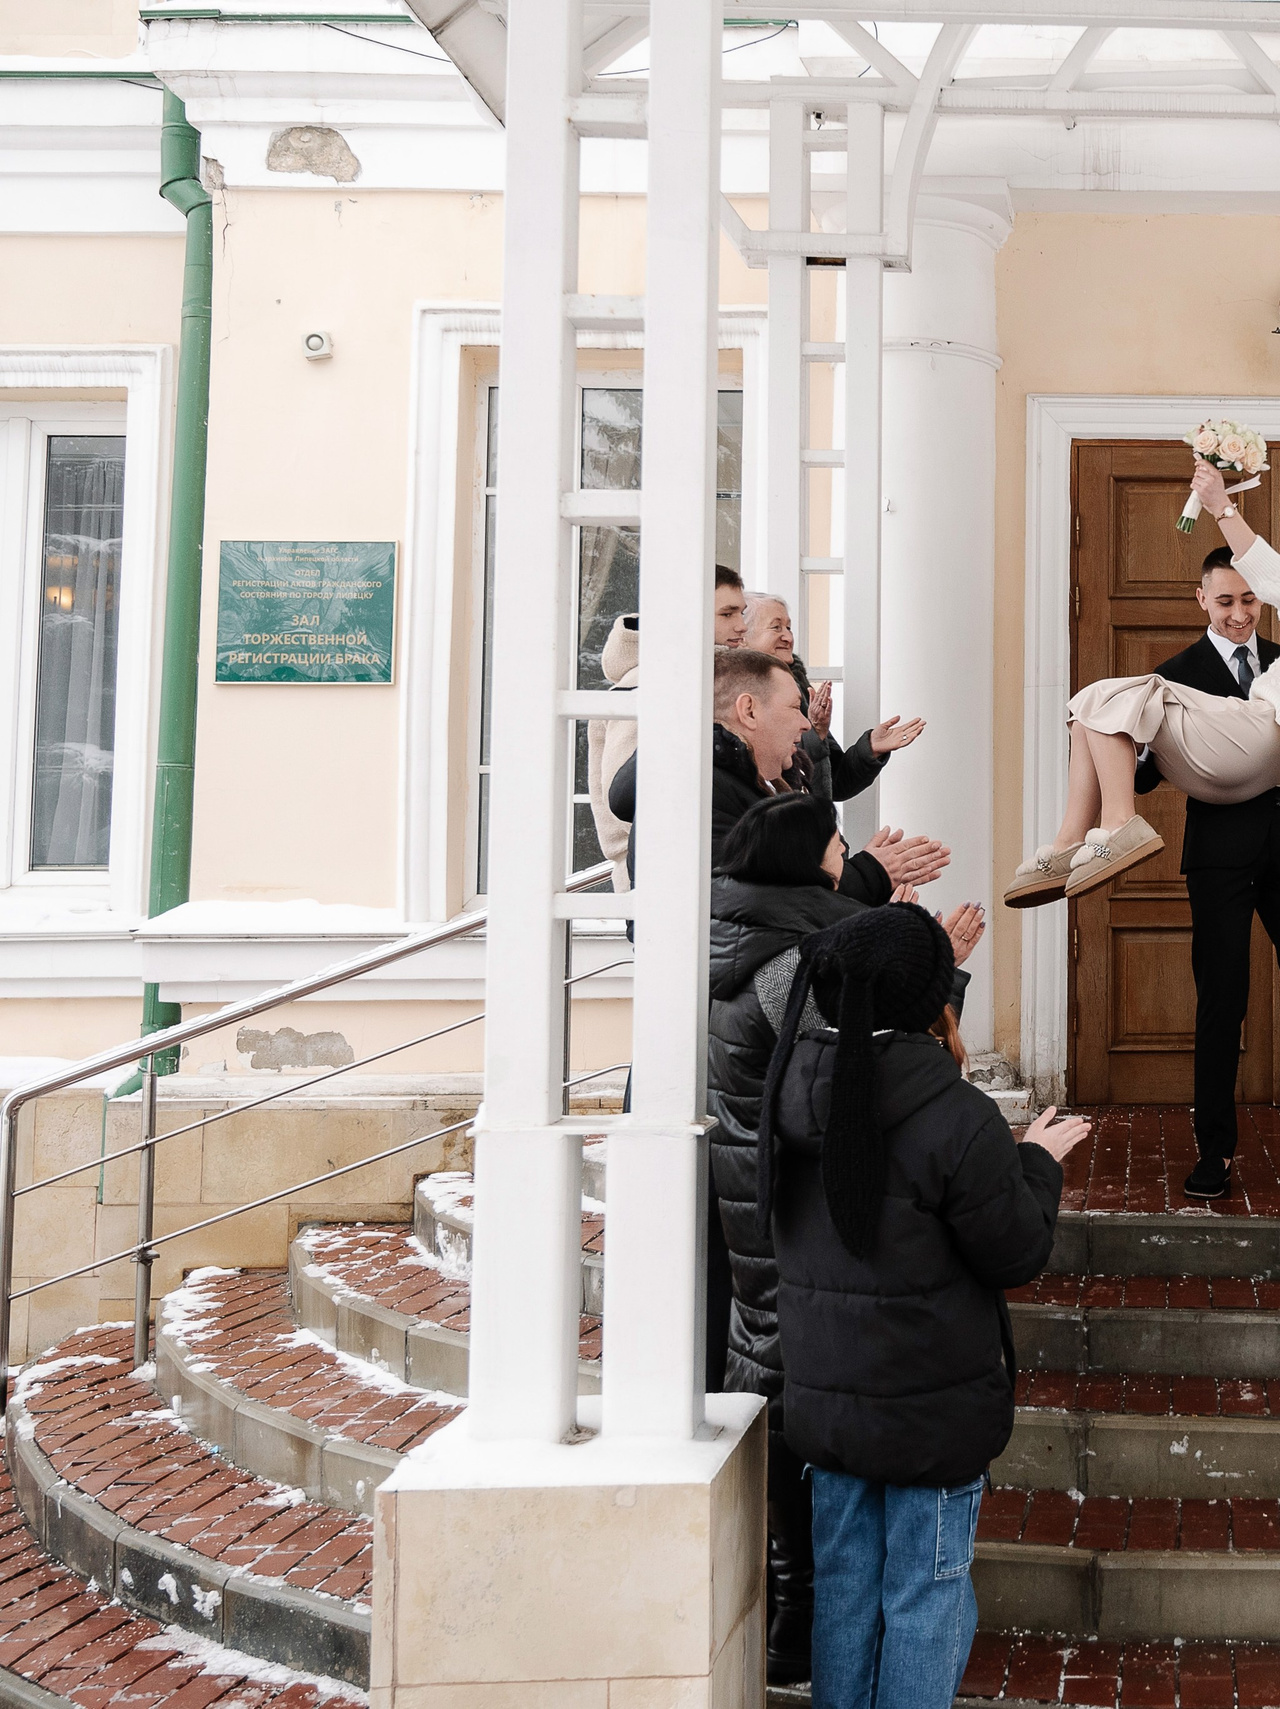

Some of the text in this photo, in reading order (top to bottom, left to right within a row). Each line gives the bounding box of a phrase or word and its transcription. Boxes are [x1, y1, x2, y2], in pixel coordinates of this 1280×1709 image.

[294, 555, 329, 563] Липецкой
[294, 569, 321, 577] ОТДЕЛ
[232, 580, 383, 589] РЕГИСТРАЦИИ АКТОВ ГРАЖДАНСКОГО
[239, 591, 374, 600] СОСТОЯНИЯ ПО ГОРОДУ ЛИПЕЦКУ
[291, 615, 320, 626] ЗАЛ
[243, 632, 368, 645] ТОРЖЕСТВЕННОЙ
[229, 653, 381, 666] РЕГИСТРАЦИИ БРАКА
